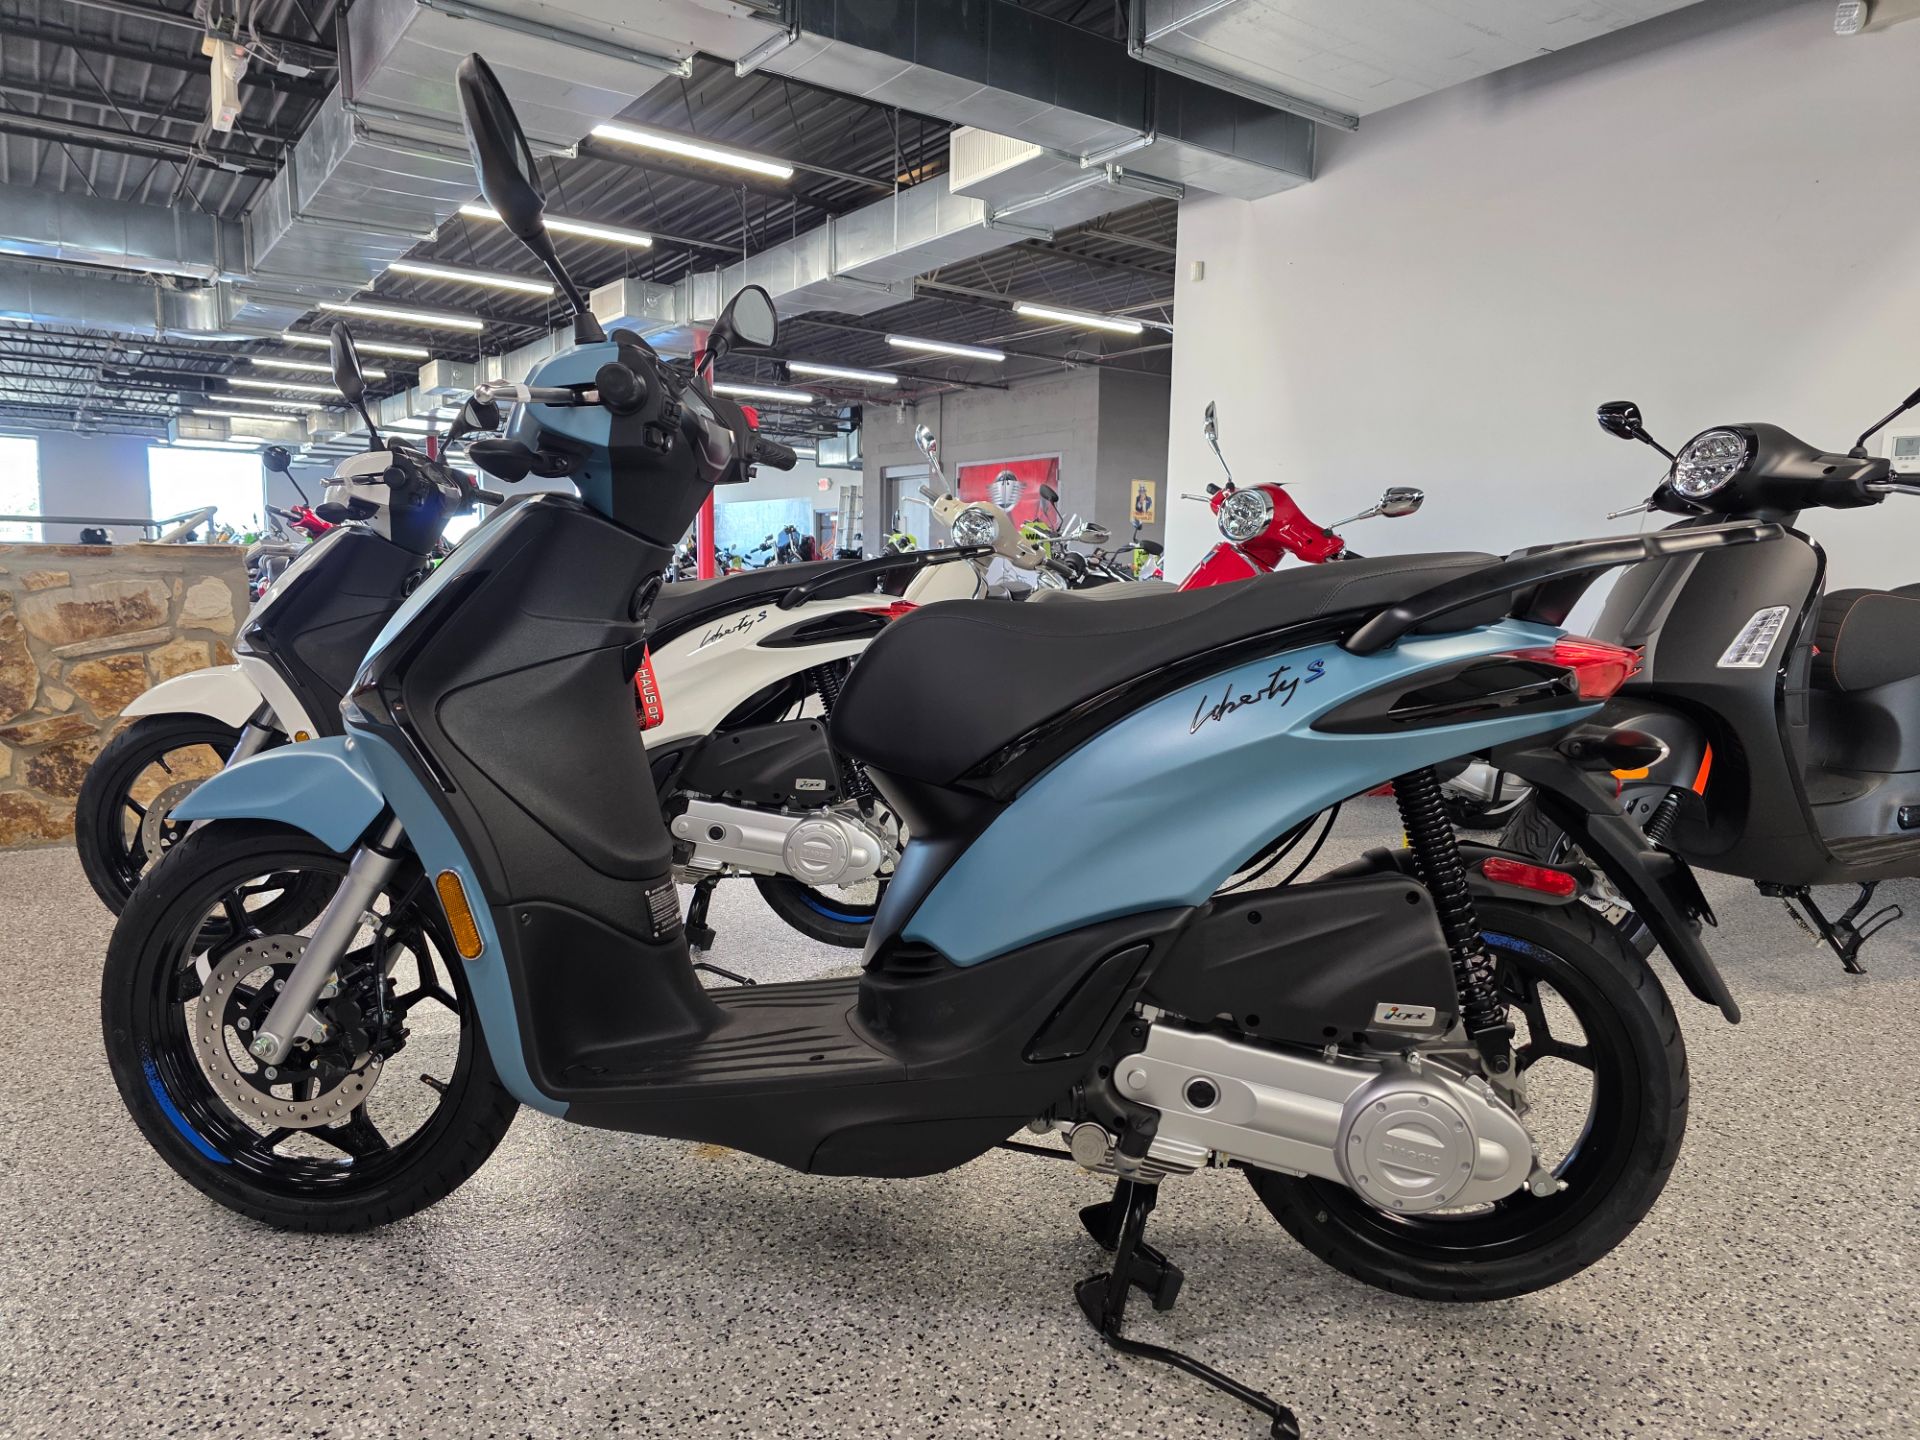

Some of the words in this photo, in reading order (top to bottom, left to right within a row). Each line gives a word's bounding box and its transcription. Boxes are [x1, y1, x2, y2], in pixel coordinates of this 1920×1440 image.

[700, 614, 755, 648] Liberty
[1190, 665, 1300, 735] Liberty
[1304, 658, 1326, 684] S
